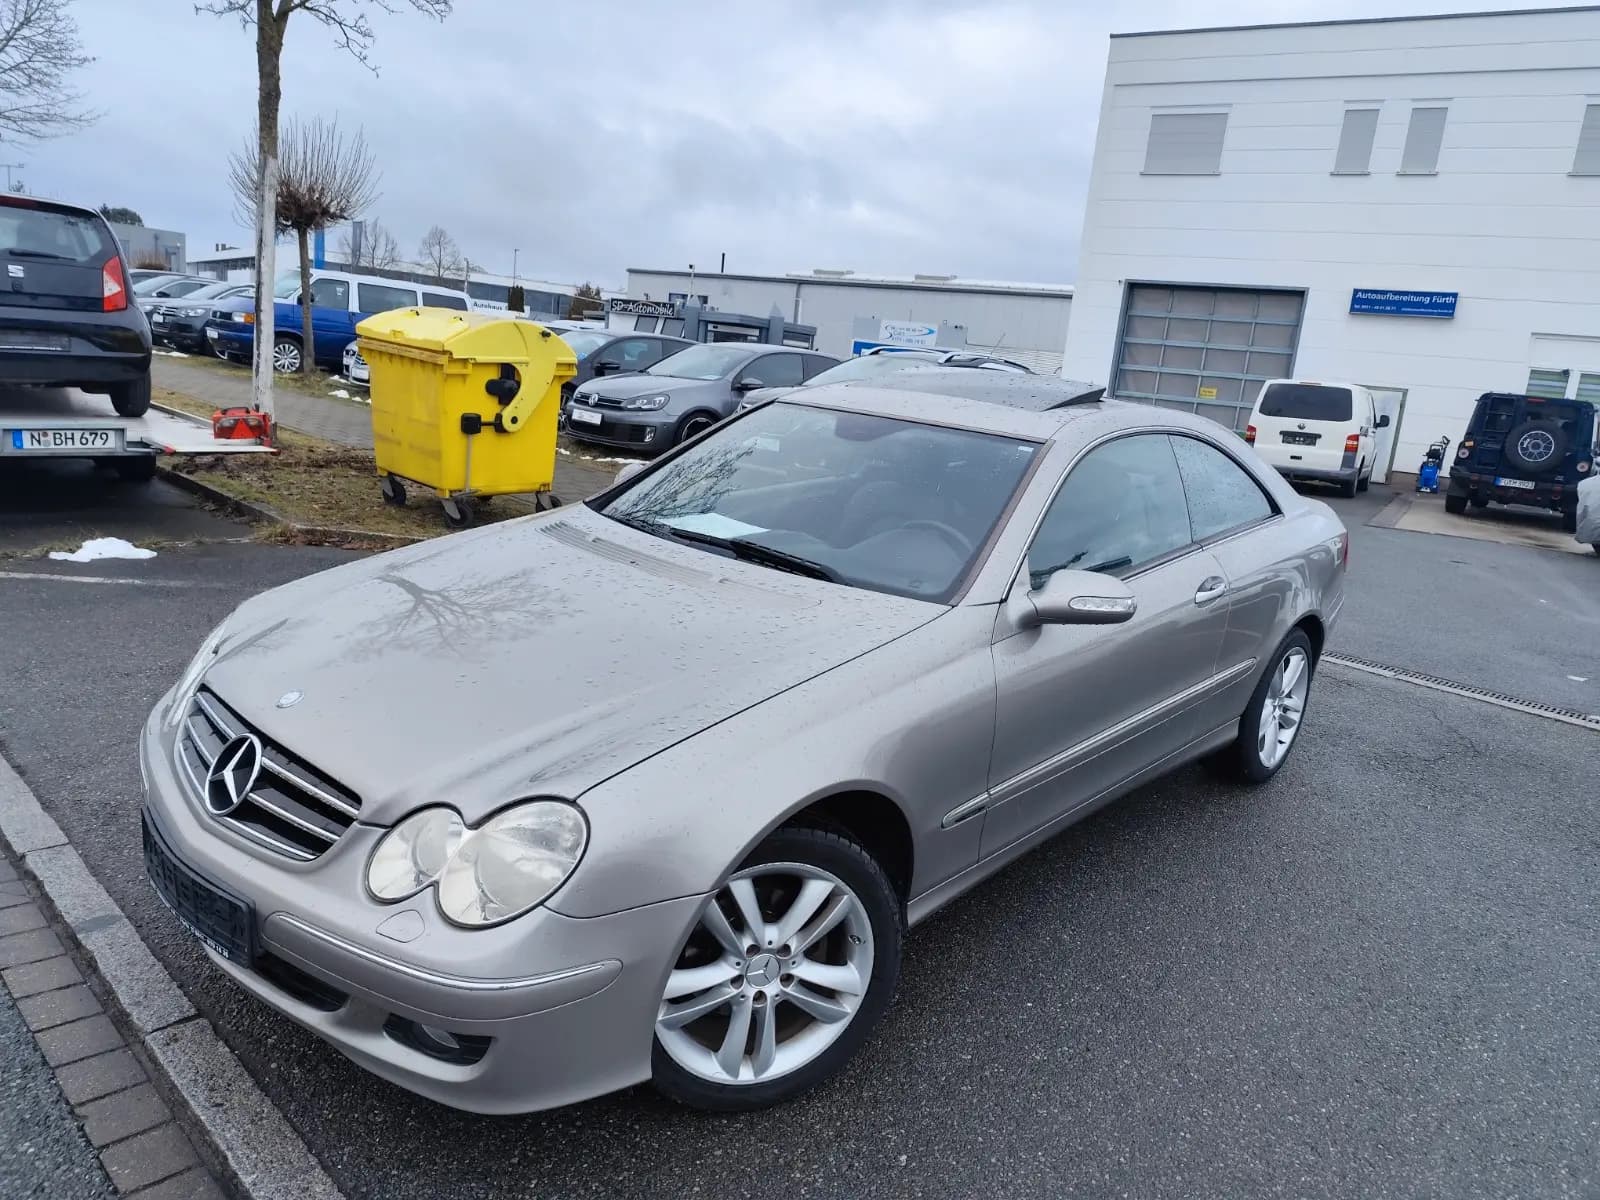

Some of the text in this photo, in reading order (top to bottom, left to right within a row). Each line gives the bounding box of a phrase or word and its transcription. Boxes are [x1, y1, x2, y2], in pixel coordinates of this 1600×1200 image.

[1355, 291, 1455, 304] Autoaufbereitung Fürth
[473, 301, 503, 311] Autohaus
[611, 300, 674, 316] SD-Automobile
[30, 431, 109, 446] N BH 679
